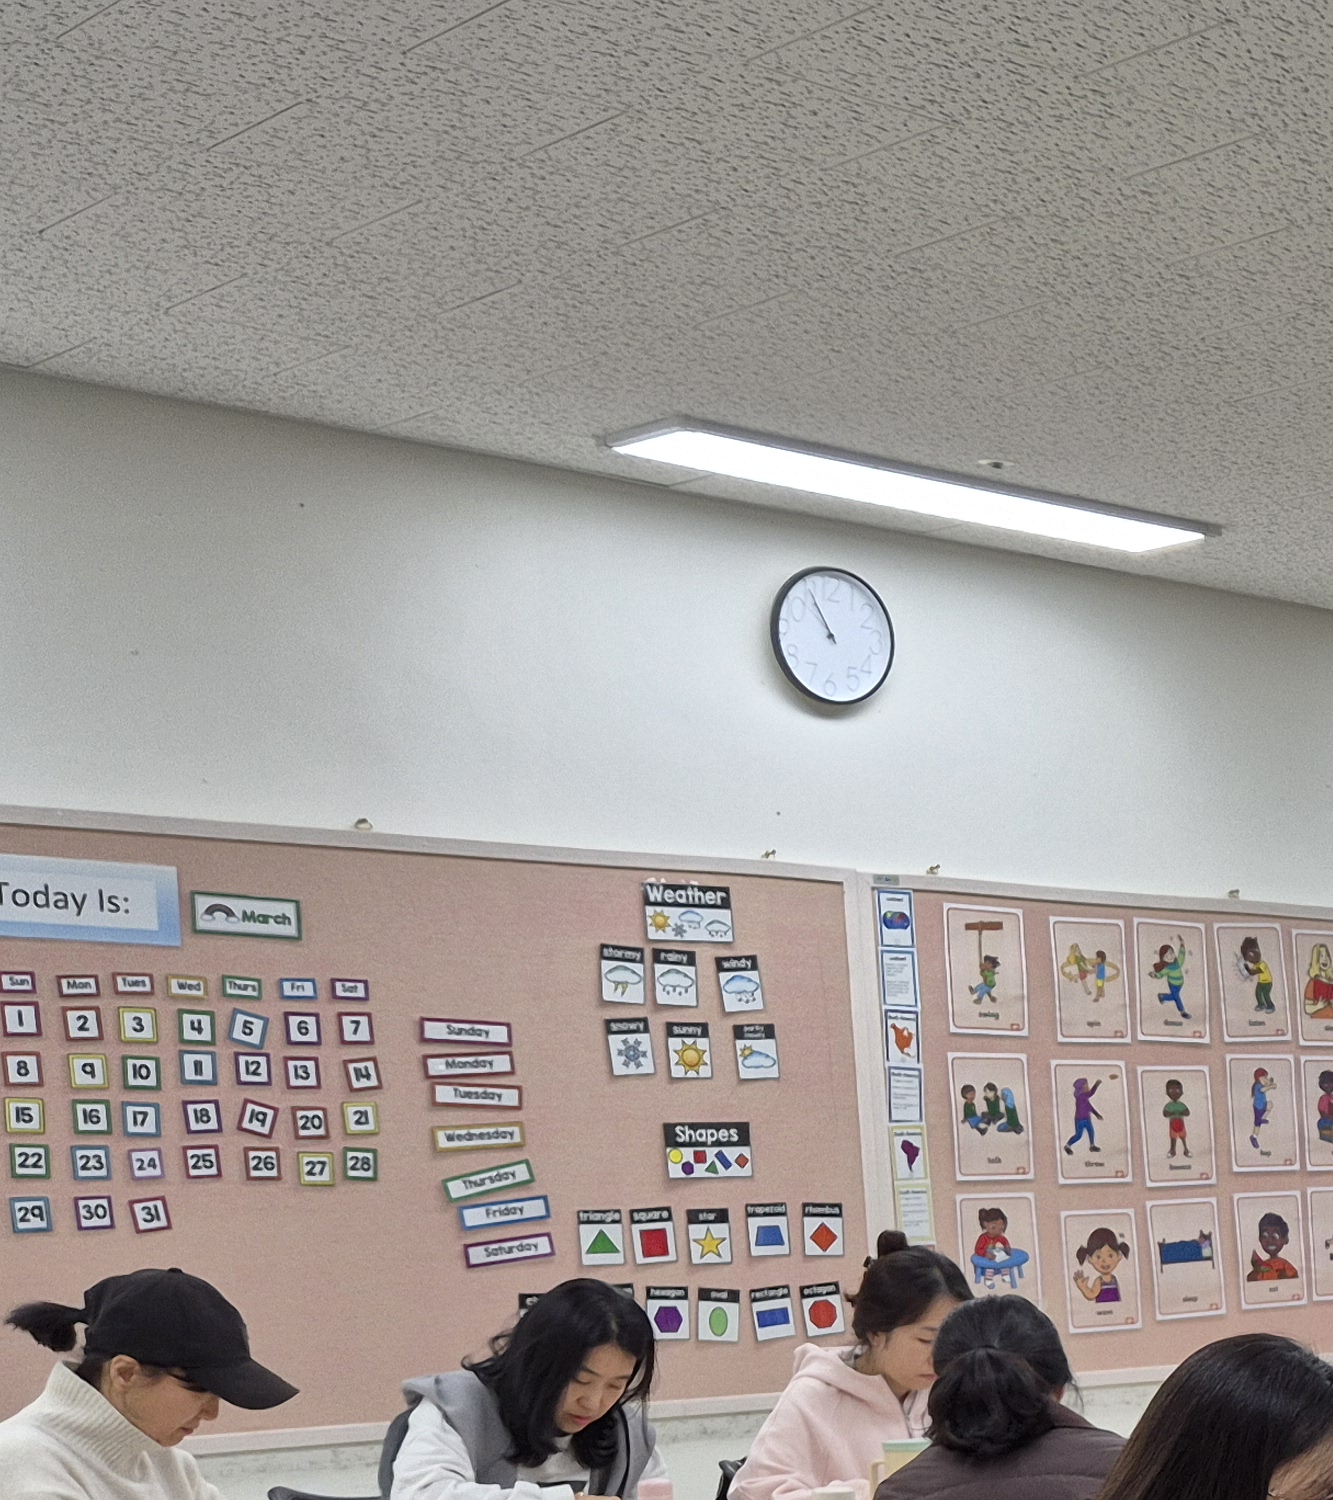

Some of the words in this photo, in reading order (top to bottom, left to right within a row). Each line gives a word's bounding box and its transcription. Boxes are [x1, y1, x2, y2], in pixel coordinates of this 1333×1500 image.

[99, 888, 130, 914] Is:
[646, 885, 728, 905] Weather
[242, 909, 291, 926] March
[722, 959, 752, 970] windy
[9, 976, 29, 986] Sun
[67, 979, 92, 990] Mon
[122, 976, 147, 988] Tues
[178, 980, 202, 991] Wed
[228, 980, 257, 993] Thurs
[290, 981, 305, 991] Fri
[342, 982, 359, 993] Sat
[18, 1010, 24, 1027] 1
[76, 1015, 89, 1031] 2
[132, 1016, 144, 1032] 3
[190, 1019, 203, 1035] 4
[242, 1020, 254, 1036] 5
[297, 1020, 309, 1036] 6
[350, 1020, 360, 1035] 7
[446, 1024, 491, 1039] Sunday
[17, 1060, 29, 1076] 8
[82, 1063, 96, 1078] 9
[132, 1063, 151, 1080] 10
[194, 1060, 203, 1076] 11
[245, 1060, 261, 1076] 12
[445, 1056, 494, 1072] Monday
[293, 1065, 310, 1080] 13
[353, 1066, 371, 1082] 14
[452, 1087, 502, 1103] Tuesday
[15, 1107, 33, 1123] 15
[83, 1108, 100, 1124] 16
[133, 1111, 148, 1127] 17
[193, 1108, 211, 1124] 18
[248, 1110, 267, 1127] 19
[353, 1110, 369, 1125] 21
[298, 1115, 322, 1132] 20
[444, 1127, 515, 1143] Wednesday
[675, 1125, 739, 1144] Shapes
[18, 1152, 43, 1168] 22
[79, 1155, 104, 1171] 23
[136, 1158, 157, 1171] 24
[190, 1154, 213, 1170] 25
[251, 1156, 275, 1171] 26
[347, 1156, 371, 1172] 28
[305, 1161, 327, 1176] 27
[462, 1169, 517, 1191] Thursday
[17, 1205, 45, 1223] 29
[82, 1204, 107, 1221] 30
[142, 1205, 161, 1222] 31
[485, 1204, 525, 1219] Friday
[579, 1210, 620, 1223] triangle
[633, 1209, 669, 1221] square
[484, 1239, 539, 1258] Saturday
